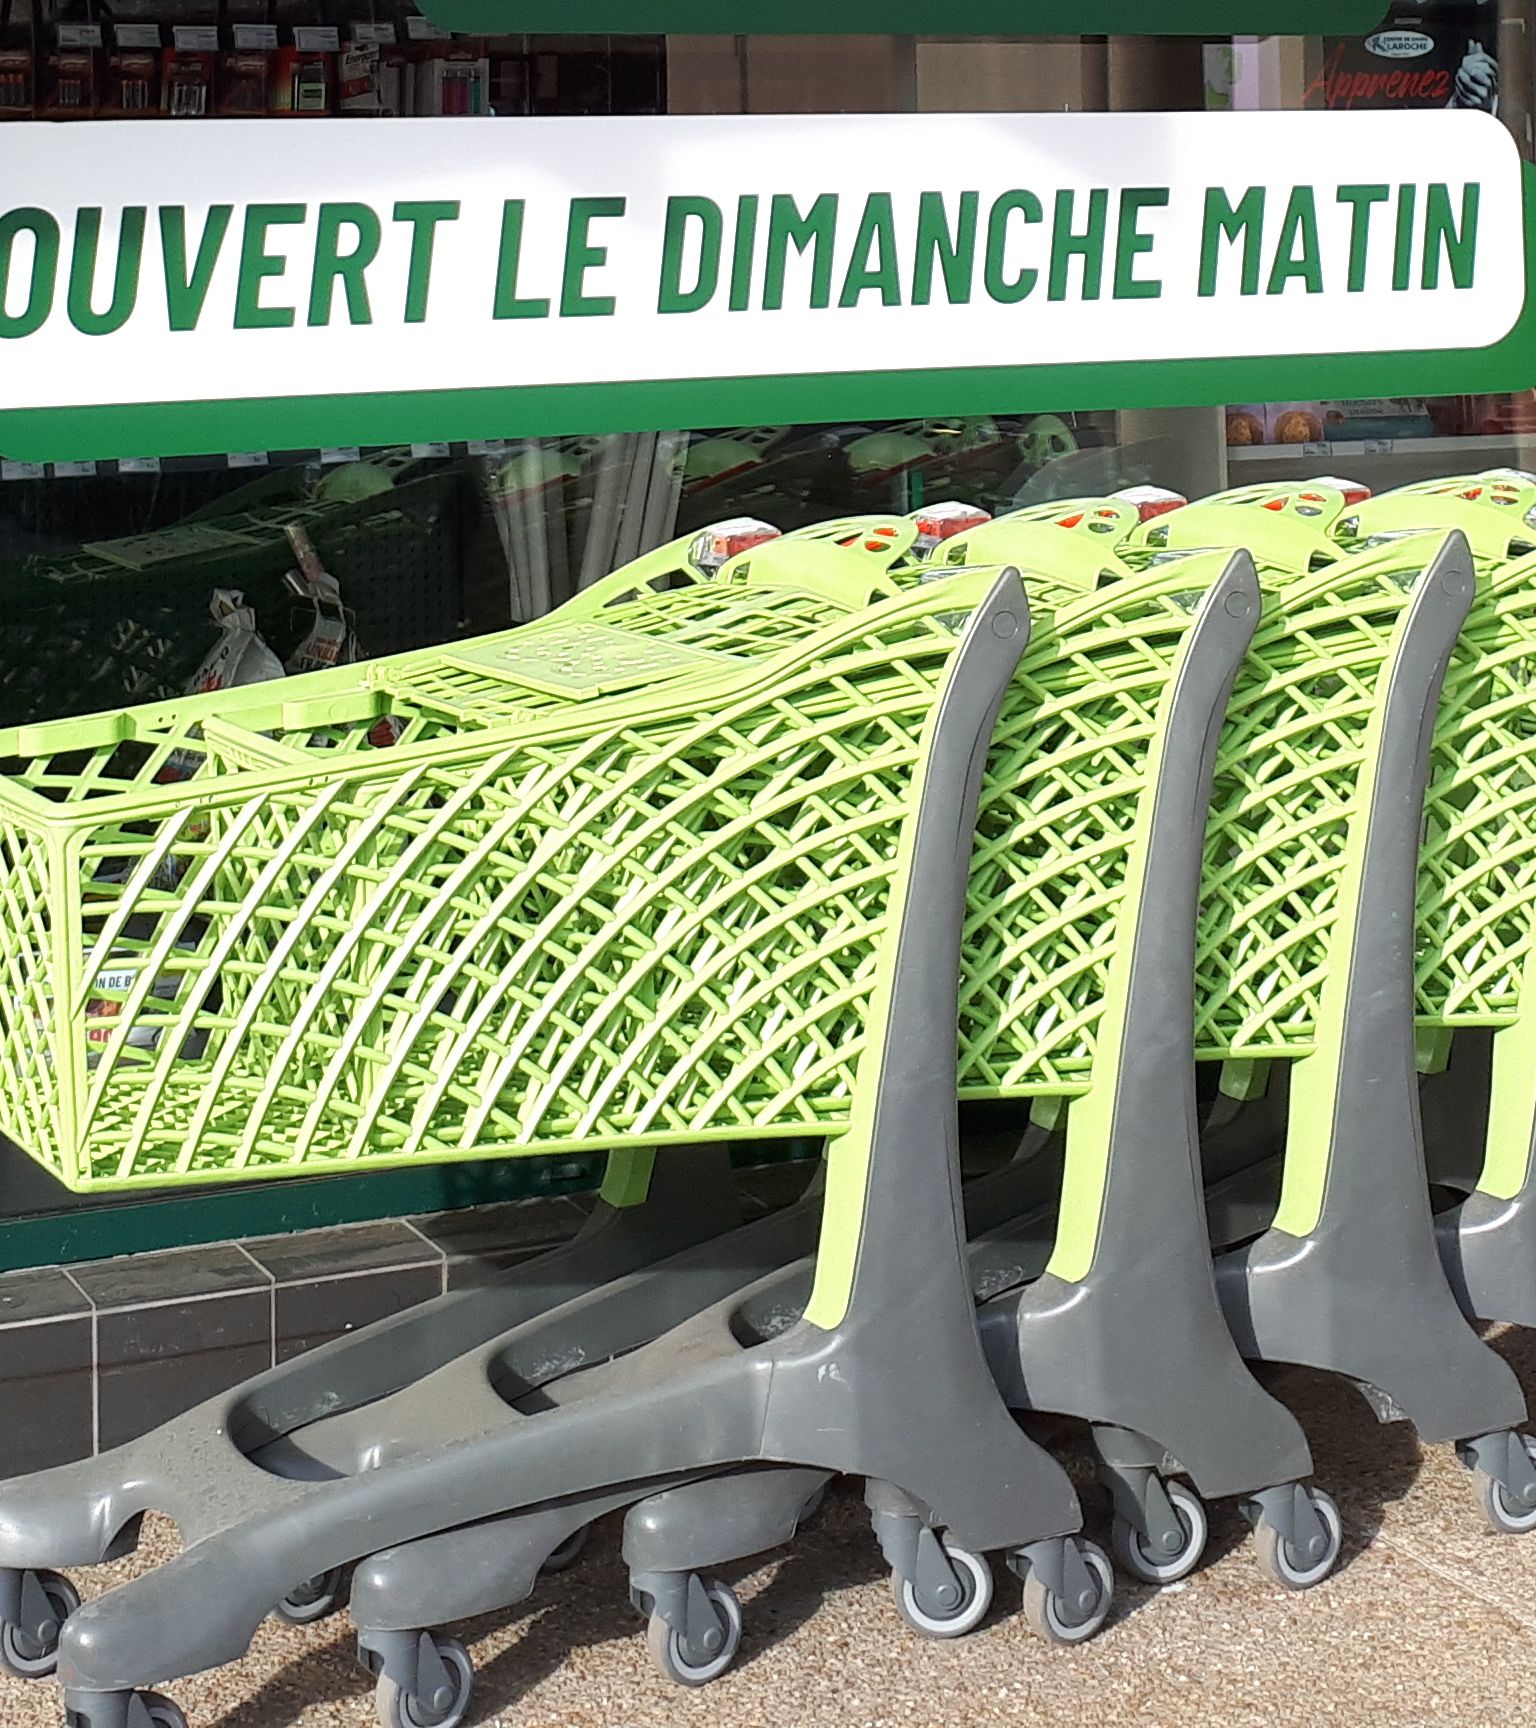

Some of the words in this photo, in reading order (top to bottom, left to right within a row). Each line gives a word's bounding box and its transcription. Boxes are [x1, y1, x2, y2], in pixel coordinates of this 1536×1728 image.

[1386, 42, 1427, 51] LAROCHE
[492, 196, 626, 320] LE
[657, 187, 1170, 314] DIMANCHE
[1197, 182, 1480, 297] MATIN
[108, 976, 122, 988] DE
